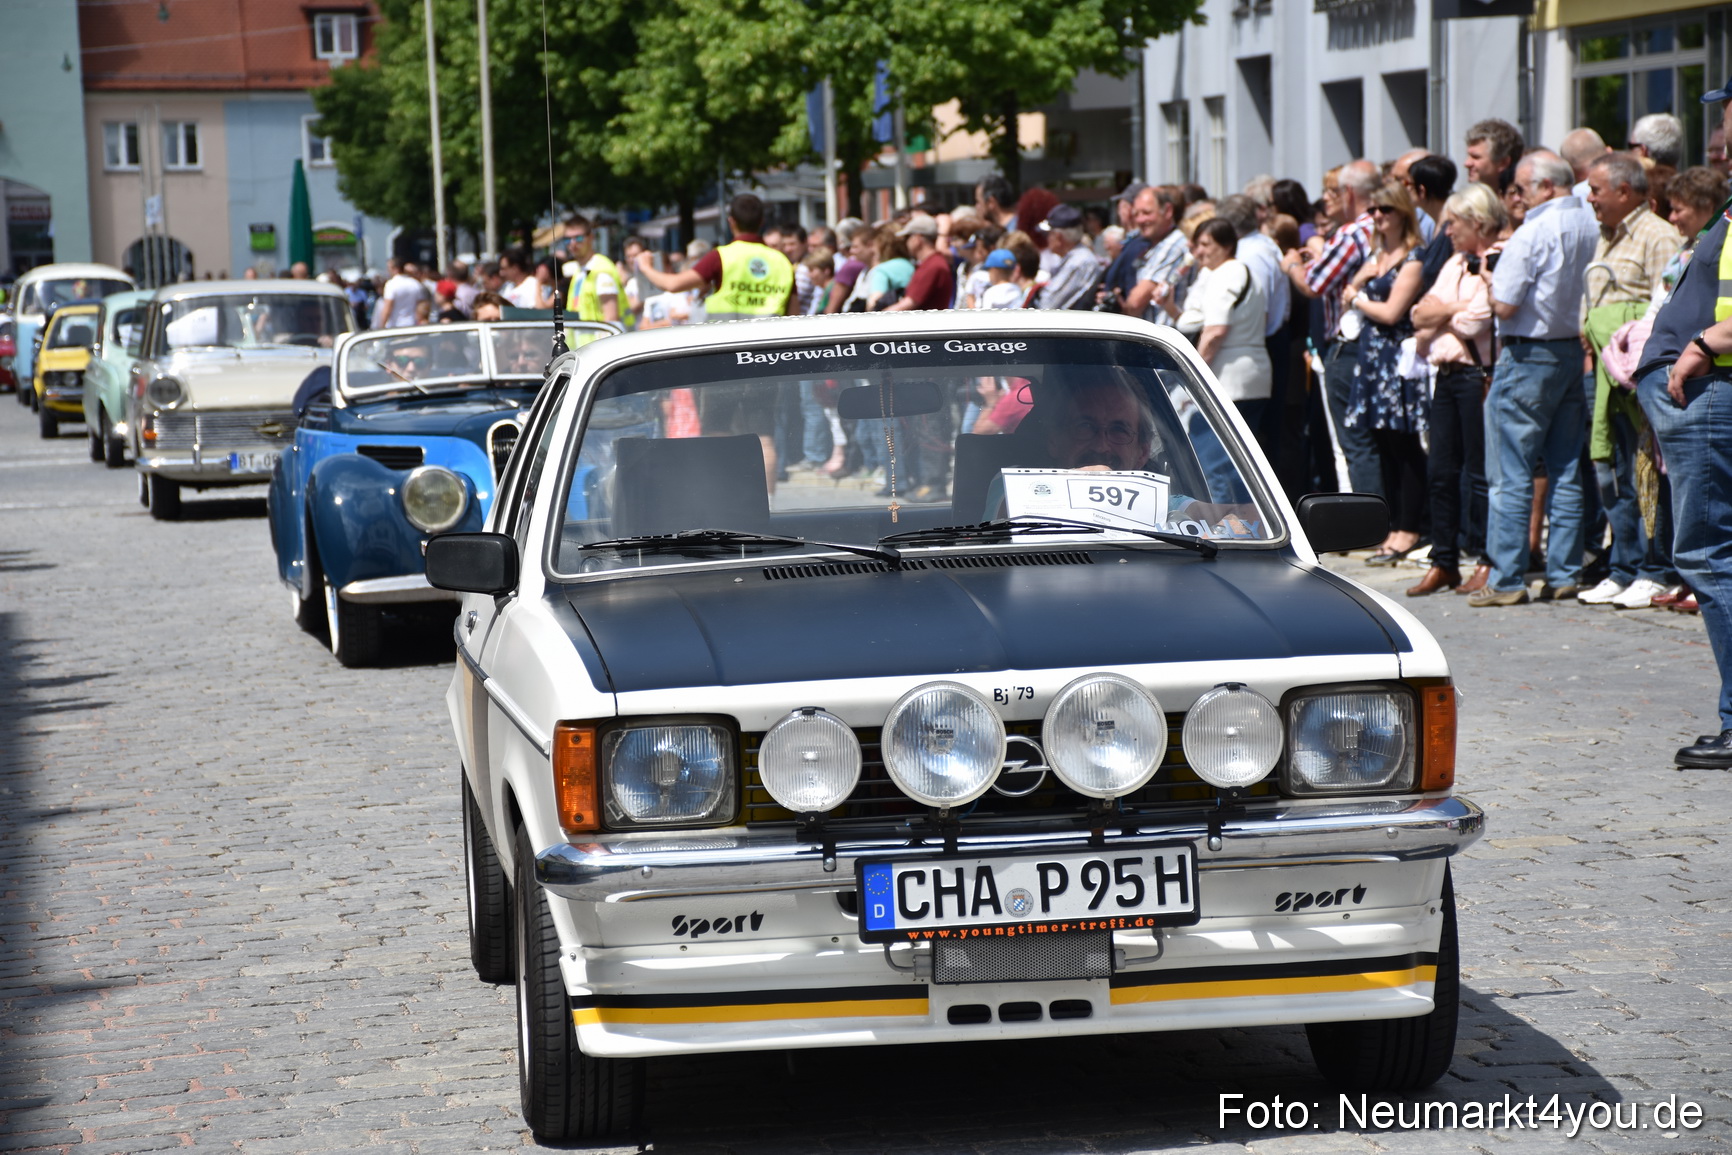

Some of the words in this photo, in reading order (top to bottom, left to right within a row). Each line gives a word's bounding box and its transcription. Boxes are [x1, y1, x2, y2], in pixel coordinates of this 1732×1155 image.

[731, 281, 786, 294] FOLLOW
[747, 297, 766, 307] ME
[736, 344, 857, 365] Bayerwald
[869, 342, 931, 355] Oldie
[944, 339, 1028, 354] Garage
[1088, 486, 1140, 511] 597
[993, 688, 1009, 706] Bj
[897, 864, 1003, 920] CHA
[1274, 882, 1367, 912] sport
[874, 904, 886, 918] D
[672, 910, 764, 938] sport
[907, 916, 1155, 939] www.youngtimer-treff.de
